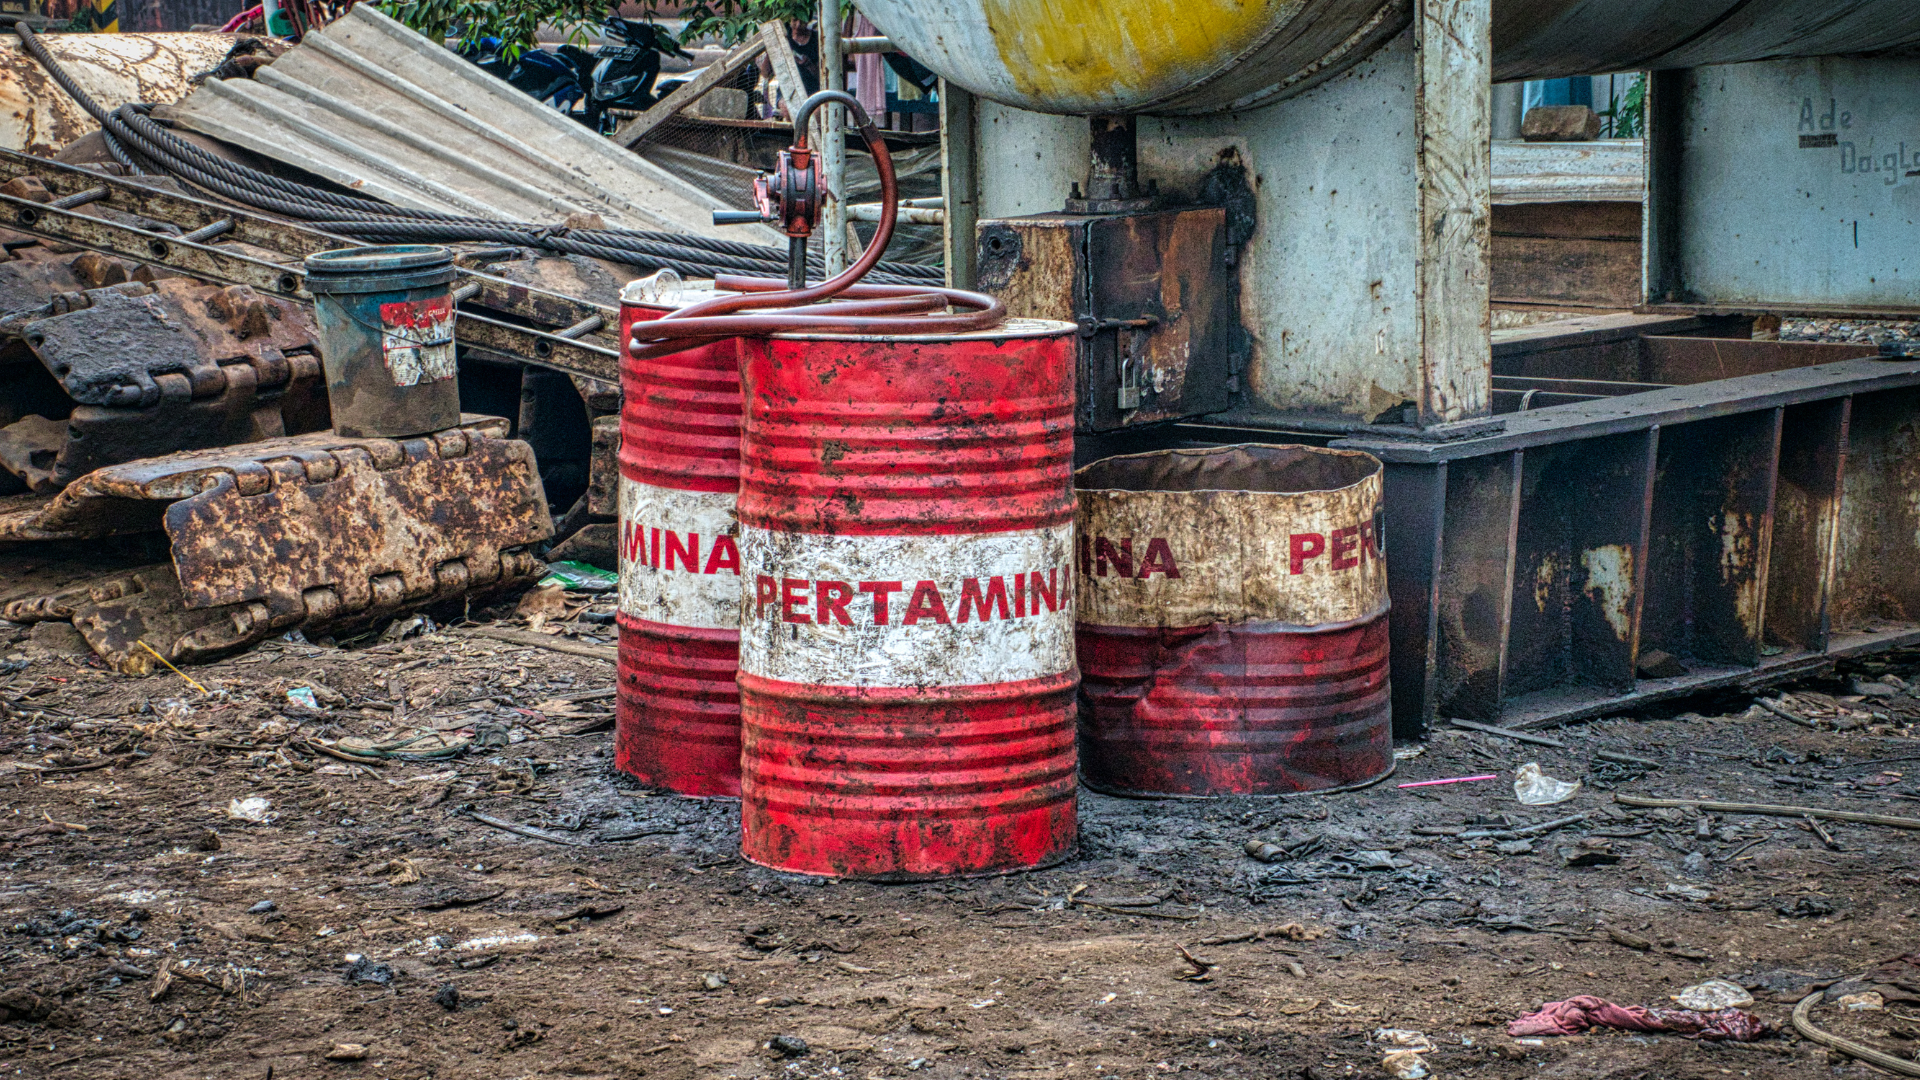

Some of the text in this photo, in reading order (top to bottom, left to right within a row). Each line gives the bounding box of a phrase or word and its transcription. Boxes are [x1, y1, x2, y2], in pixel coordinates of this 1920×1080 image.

[1798, 97, 1852, 132] Ade
[1289, 519, 1377, 576] PER
[756, 563, 1071, 626] PERTAMINA
